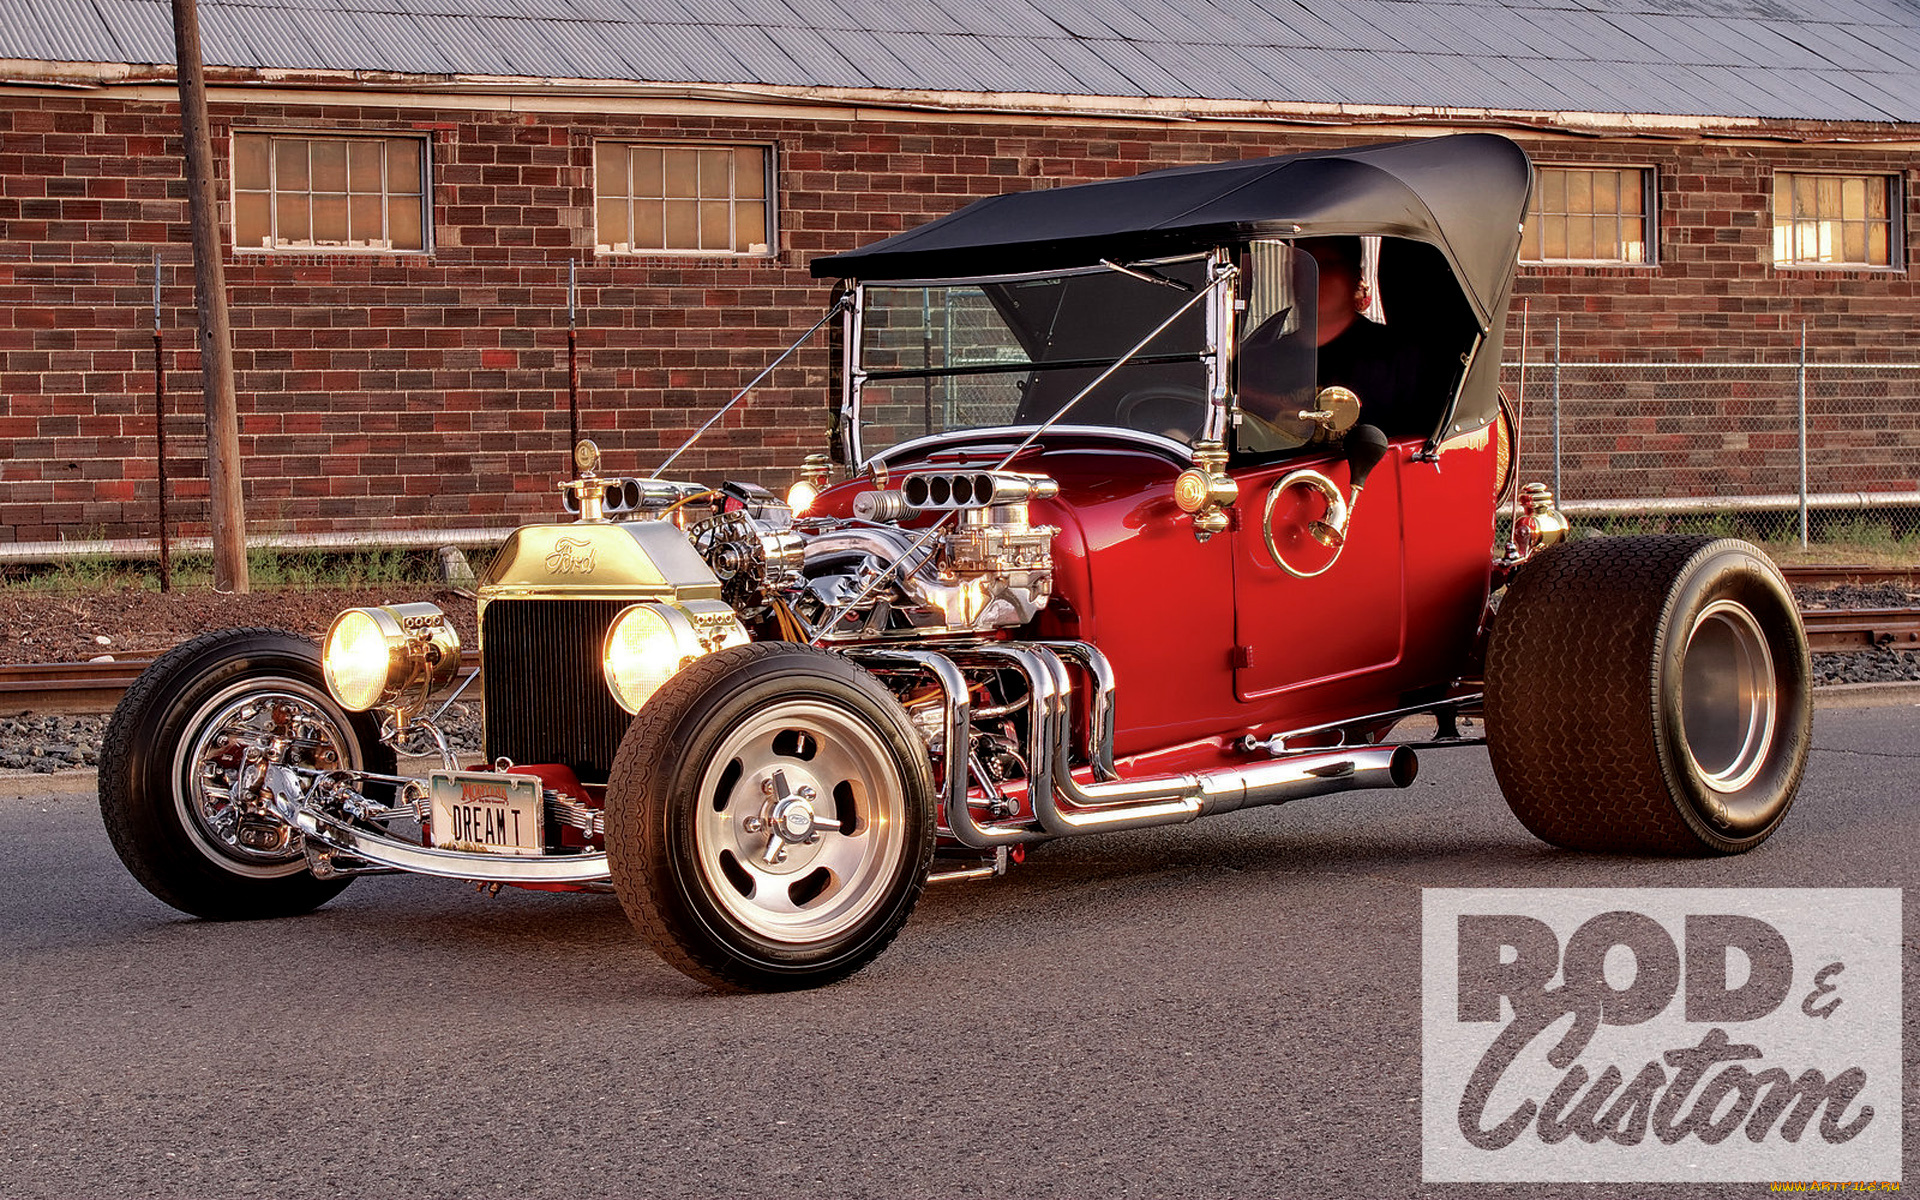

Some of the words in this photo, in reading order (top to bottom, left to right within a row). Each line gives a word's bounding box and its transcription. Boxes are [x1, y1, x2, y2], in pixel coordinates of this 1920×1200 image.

[545, 536, 597, 575] Ford
[461, 783, 508, 801] MONTANA
[453, 805, 506, 846] DREAM
[511, 809, 520, 846] T
